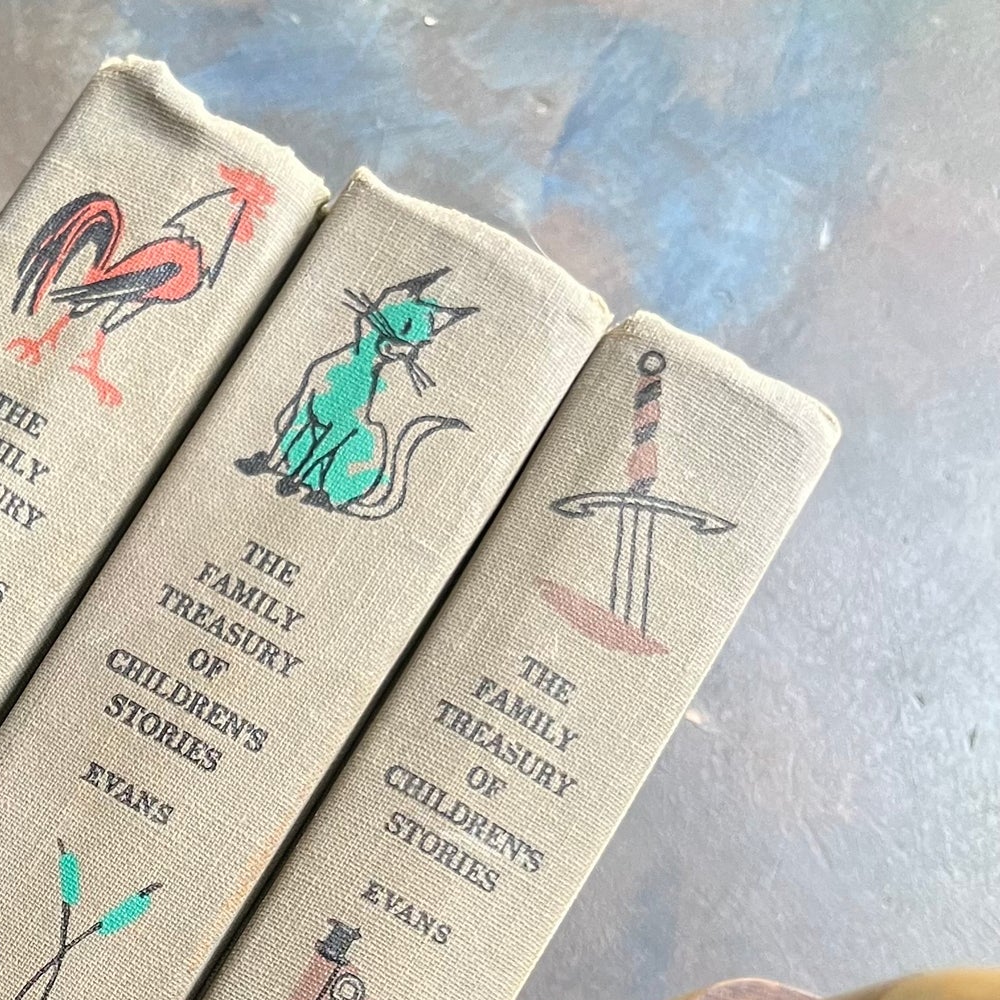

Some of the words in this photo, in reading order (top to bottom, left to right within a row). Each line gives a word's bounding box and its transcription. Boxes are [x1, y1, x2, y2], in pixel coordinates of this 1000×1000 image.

[194, 561, 305, 632] FAMILY
[240, 540, 301, 588] THE
[157, 584, 303, 678] TREASURY
[187, 648, 230, 680] OF
[105, 649, 269, 753] CHILDREN'S
[472, 676, 579, 751] FAMILY
[519, 655, 576, 705] THE
[104, 694, 223, 772] STORIES
[434, 699, 578, 798] TREASURY
[80, 761, 174, 825] EVANS
[384, 764, 545, 873] CHILDREN'S
[465, 765, 507, 799] OF
[385, 812, 500, 893] STORIES
[360, 879, 451, 945] EVANS
